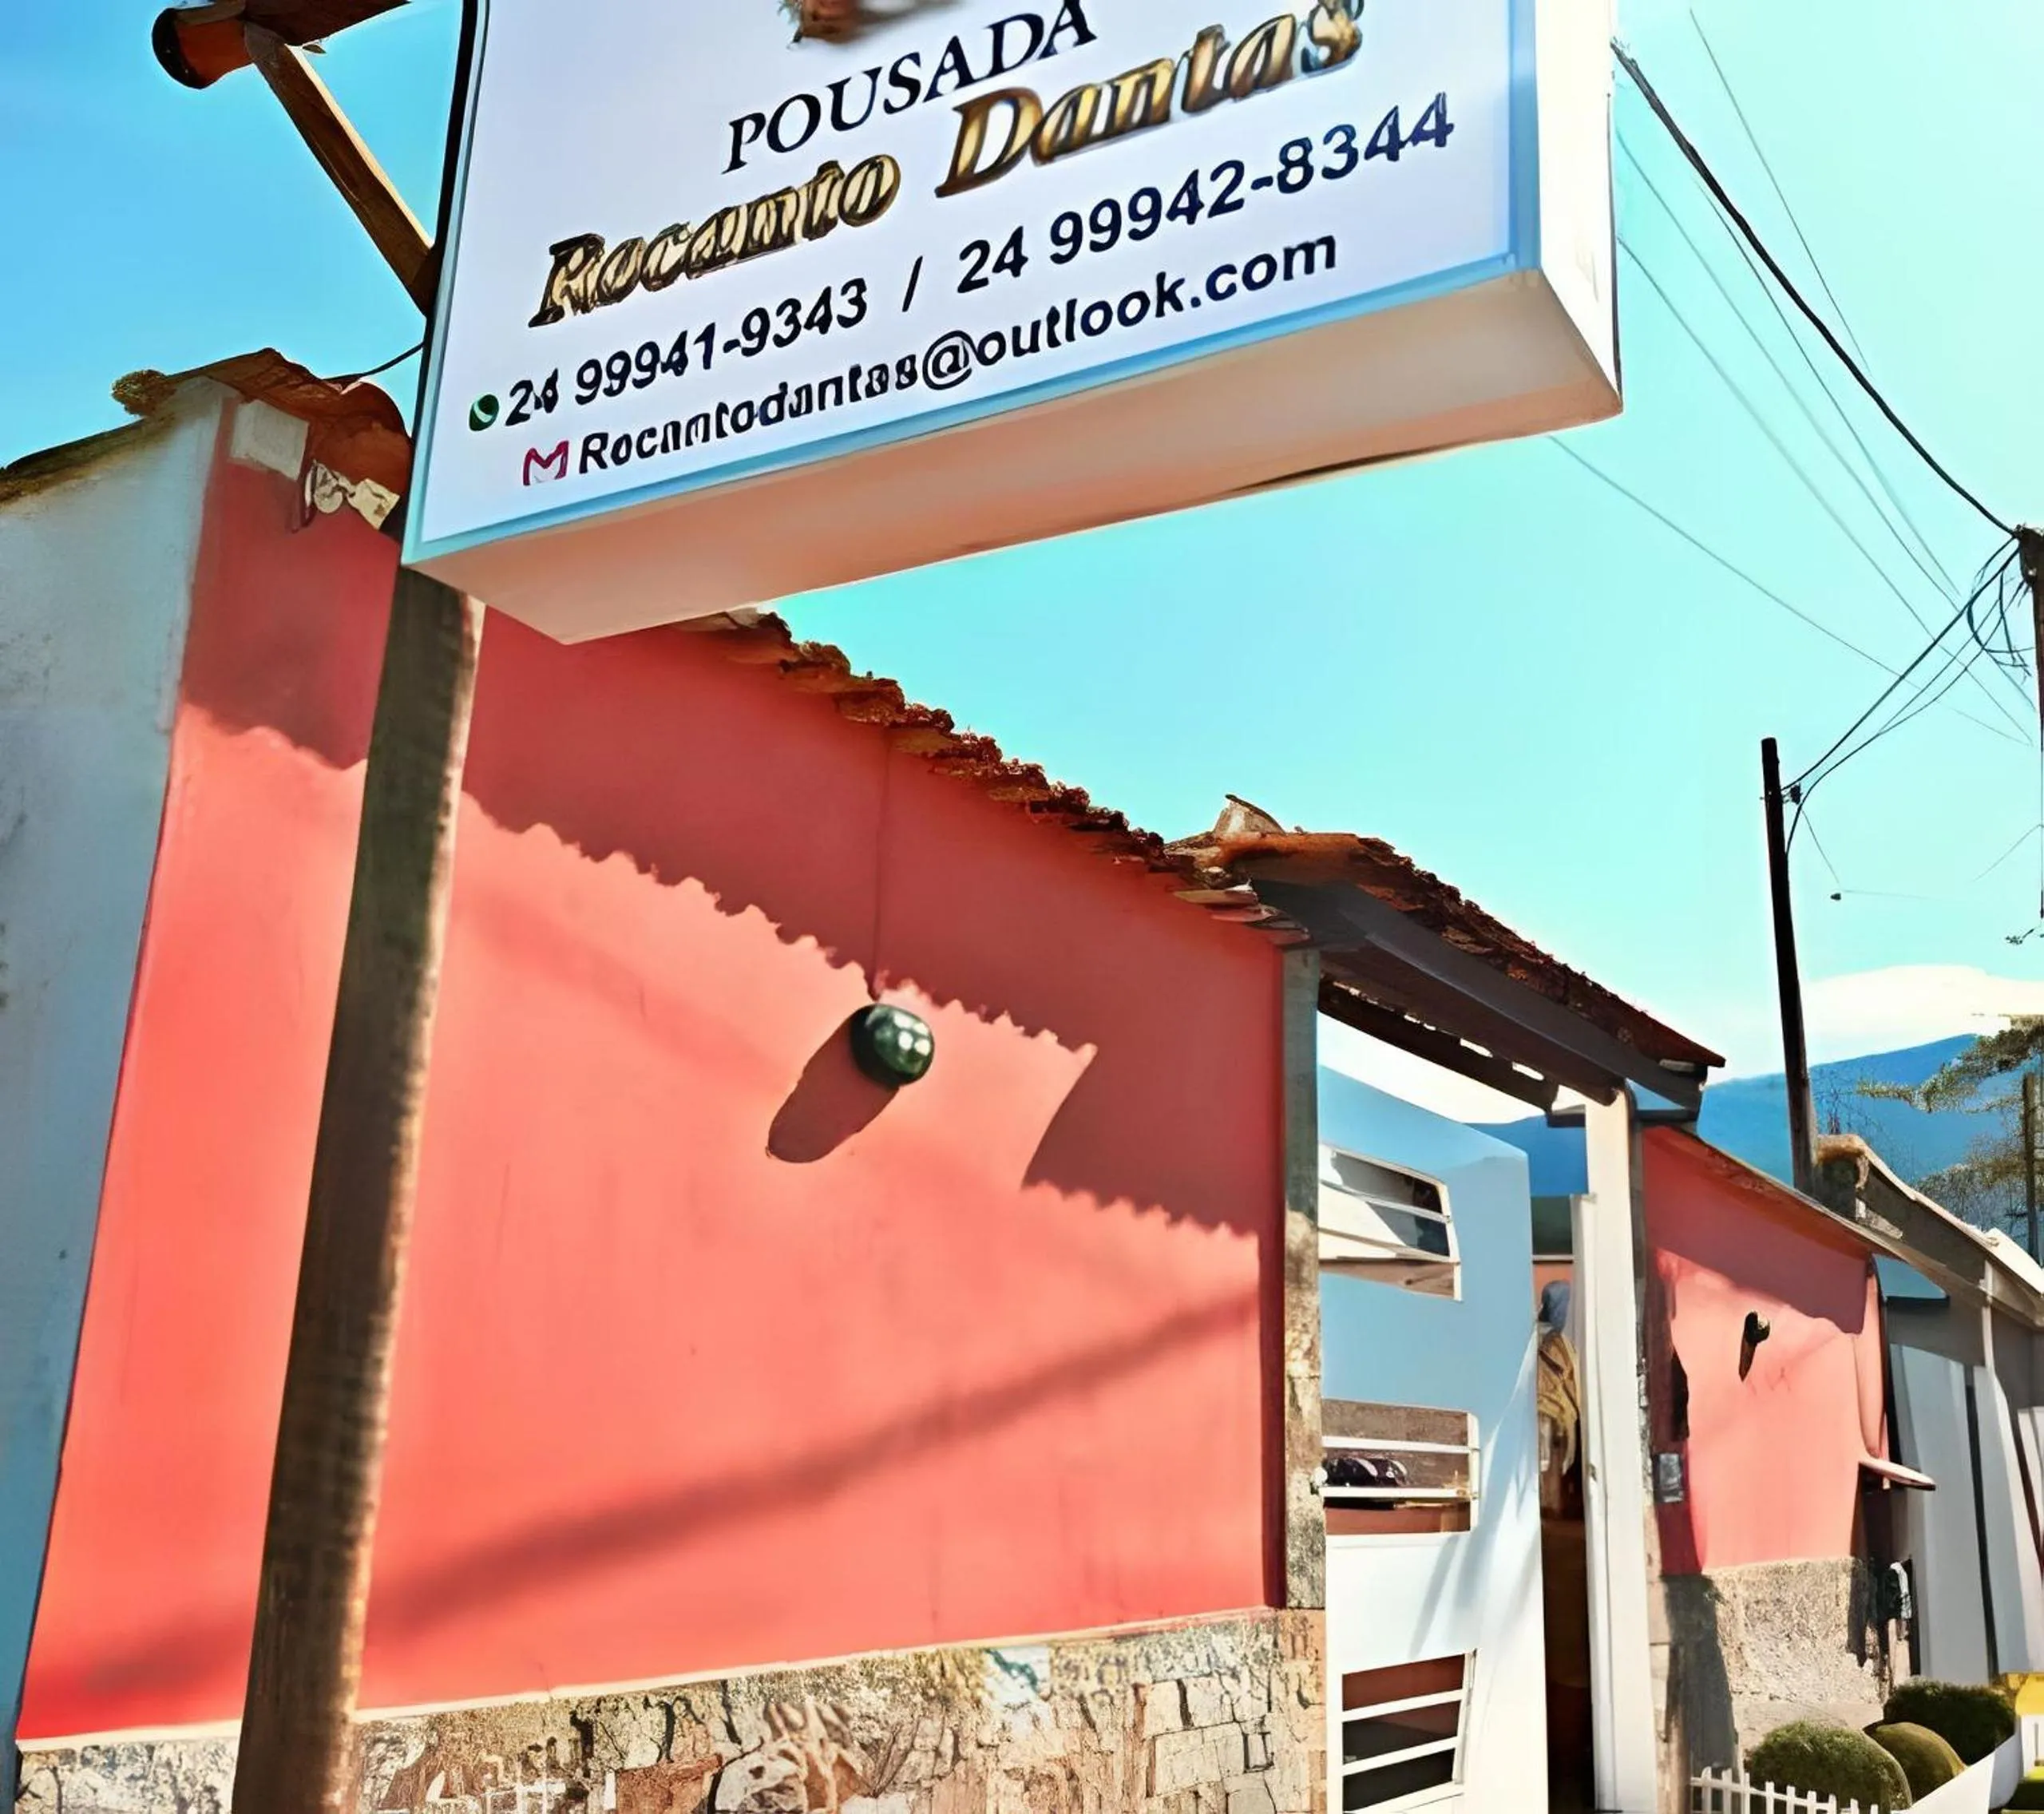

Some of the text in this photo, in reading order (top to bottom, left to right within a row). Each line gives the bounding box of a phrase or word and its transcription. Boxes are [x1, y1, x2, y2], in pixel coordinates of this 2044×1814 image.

[722, 0, 1098, 173] POUSADA
[934, 0, 1363, 198] Dantas
[505, 92, 1455, 426] 24 99941-9343 / 24 99942-8344
